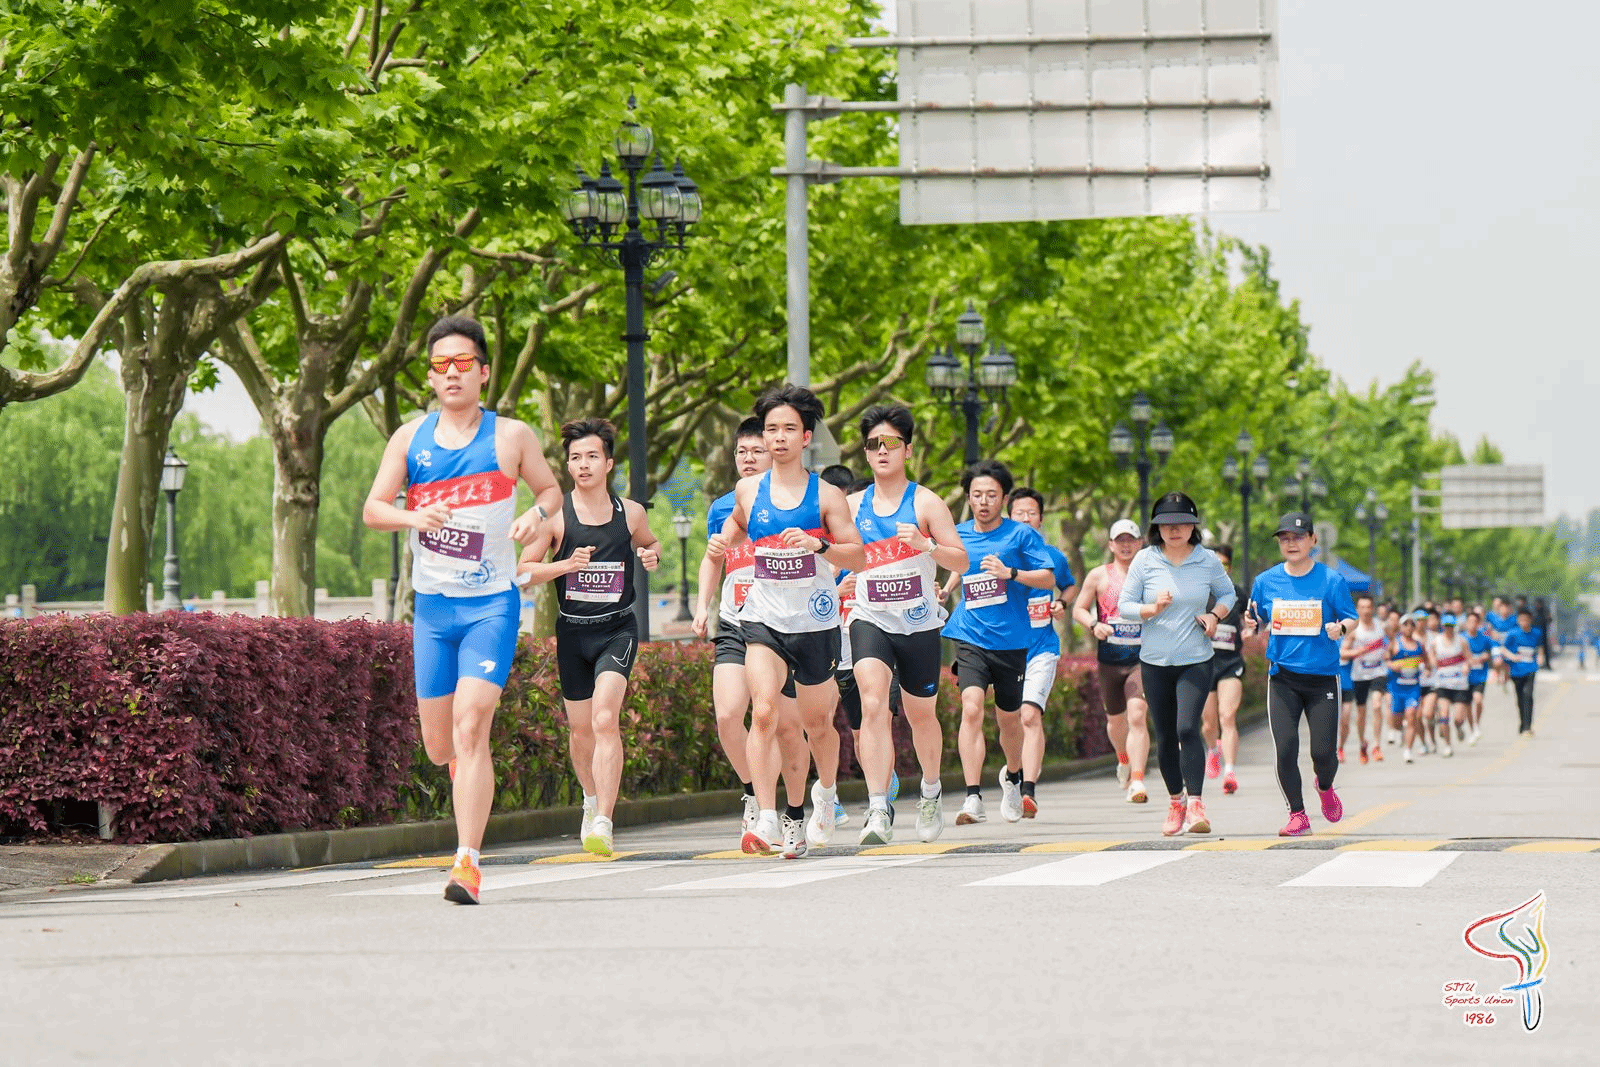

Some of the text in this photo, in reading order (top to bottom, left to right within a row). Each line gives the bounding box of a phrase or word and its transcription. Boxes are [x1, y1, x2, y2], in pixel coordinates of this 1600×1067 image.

[766, 558, 803, 571] E0018
[577, 572, 615, 584] E0017
[875, 580, 912, 593] E0075
[969, 579, 998, 594] E0016
[1280, 609, 1314, 620] D0030
